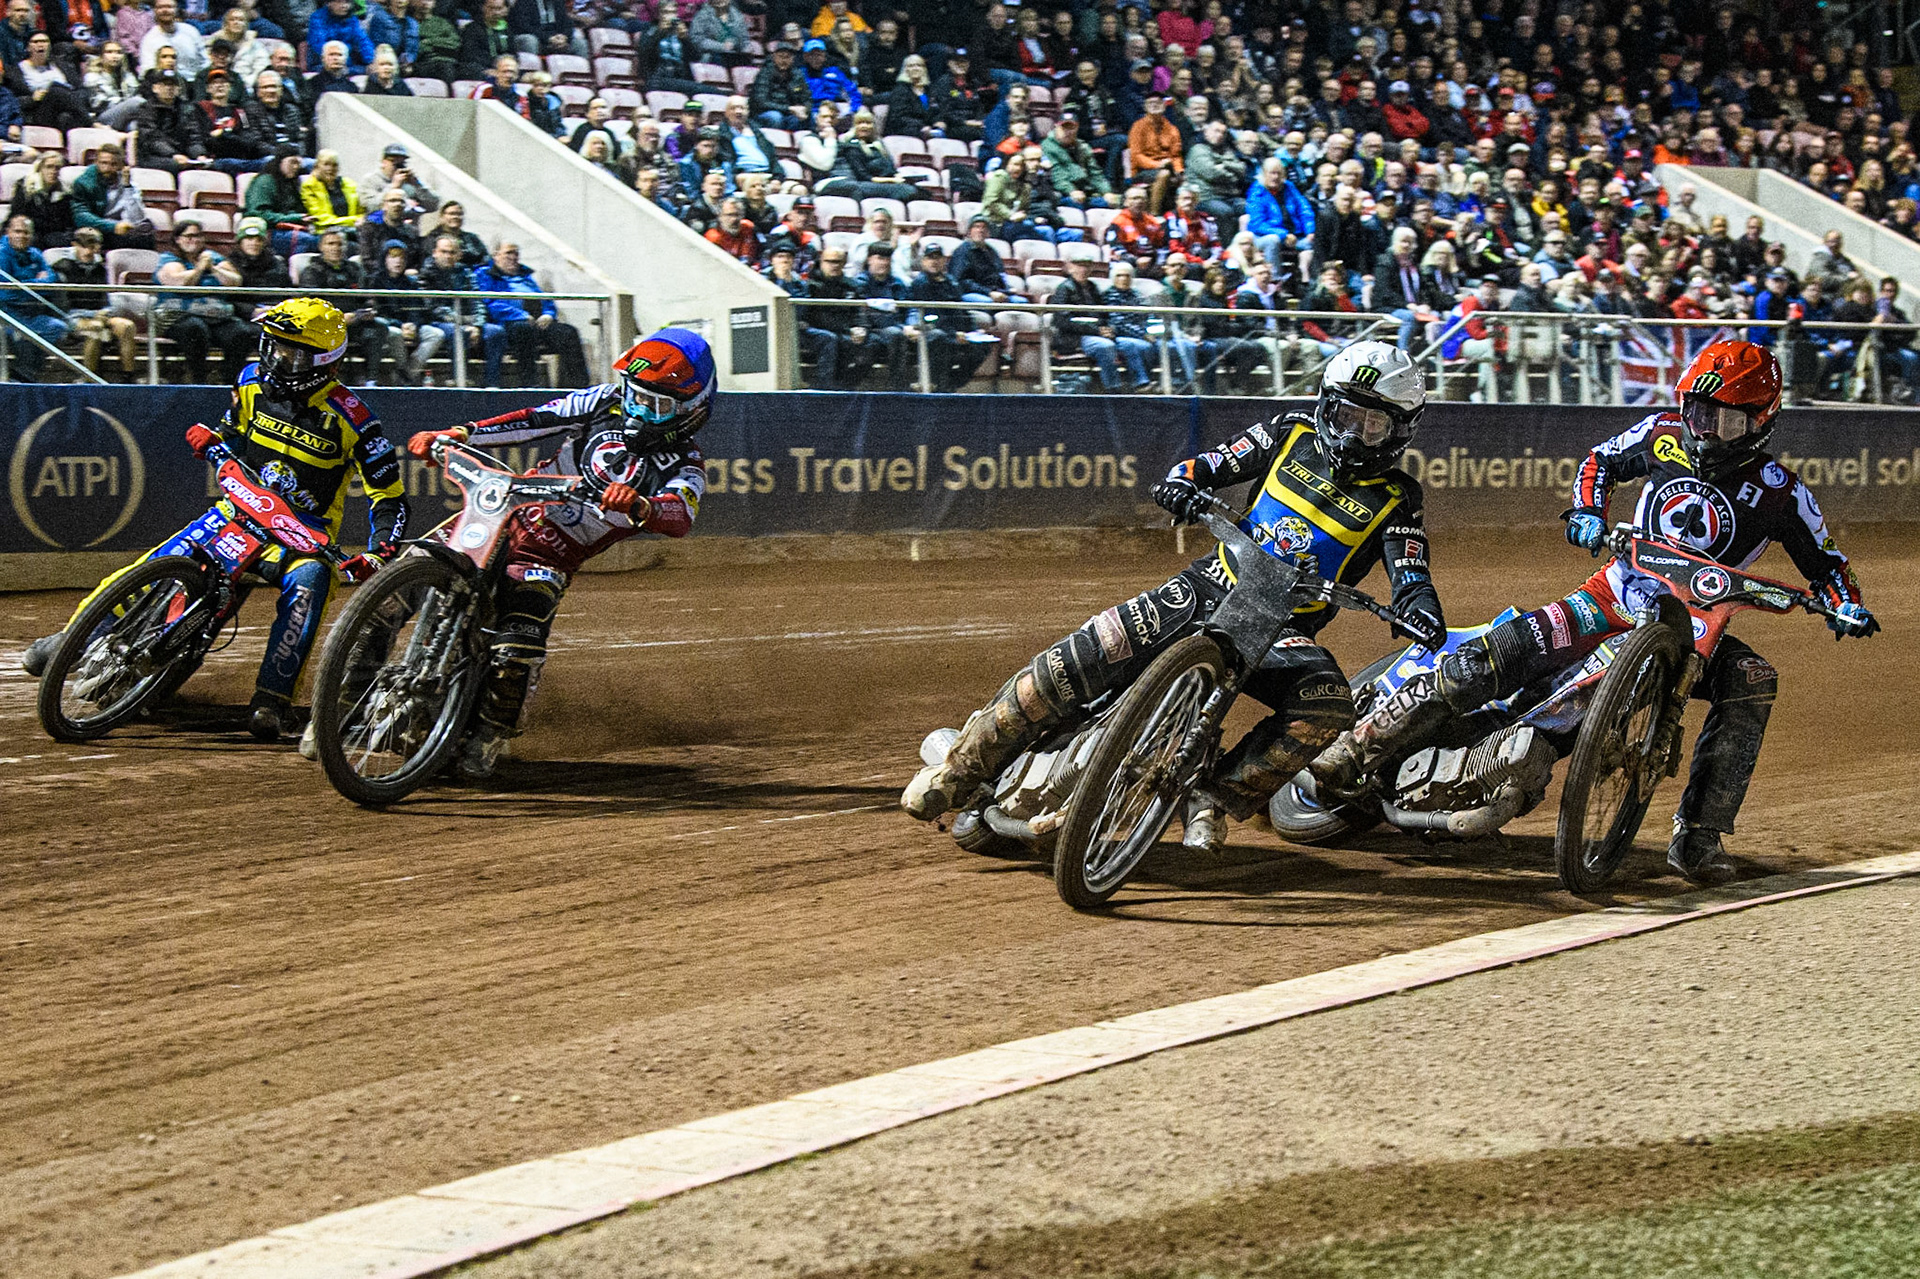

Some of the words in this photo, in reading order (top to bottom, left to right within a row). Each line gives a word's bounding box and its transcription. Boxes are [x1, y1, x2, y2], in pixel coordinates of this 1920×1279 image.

[257, 415, 283, 432] TRU
[283, 426, 332, 451] PLANT
[33, 456, 120, 498] ATPI
[789, 445, 928, 494] Travel
[943, 442, 1138, 491] Solutions
[1288, 463, 1316, 483] TRU
[1317, 482, 1368, 518] PLANT
[1401, 447, 1578, 499] Delivering
[1660, 482, 1691, 502] BELLE
[1695, 486, 1718, 502] VUE
[1716, 504, 1731, 534] ACES
[1639, 554, 1690, 568] POLCOPPER
[1167, 581, 1185, 604] ATPI
[1527, 616, 1548, 656] DOCUFY
[1049, 647, 1076, 702] GARCAREK
